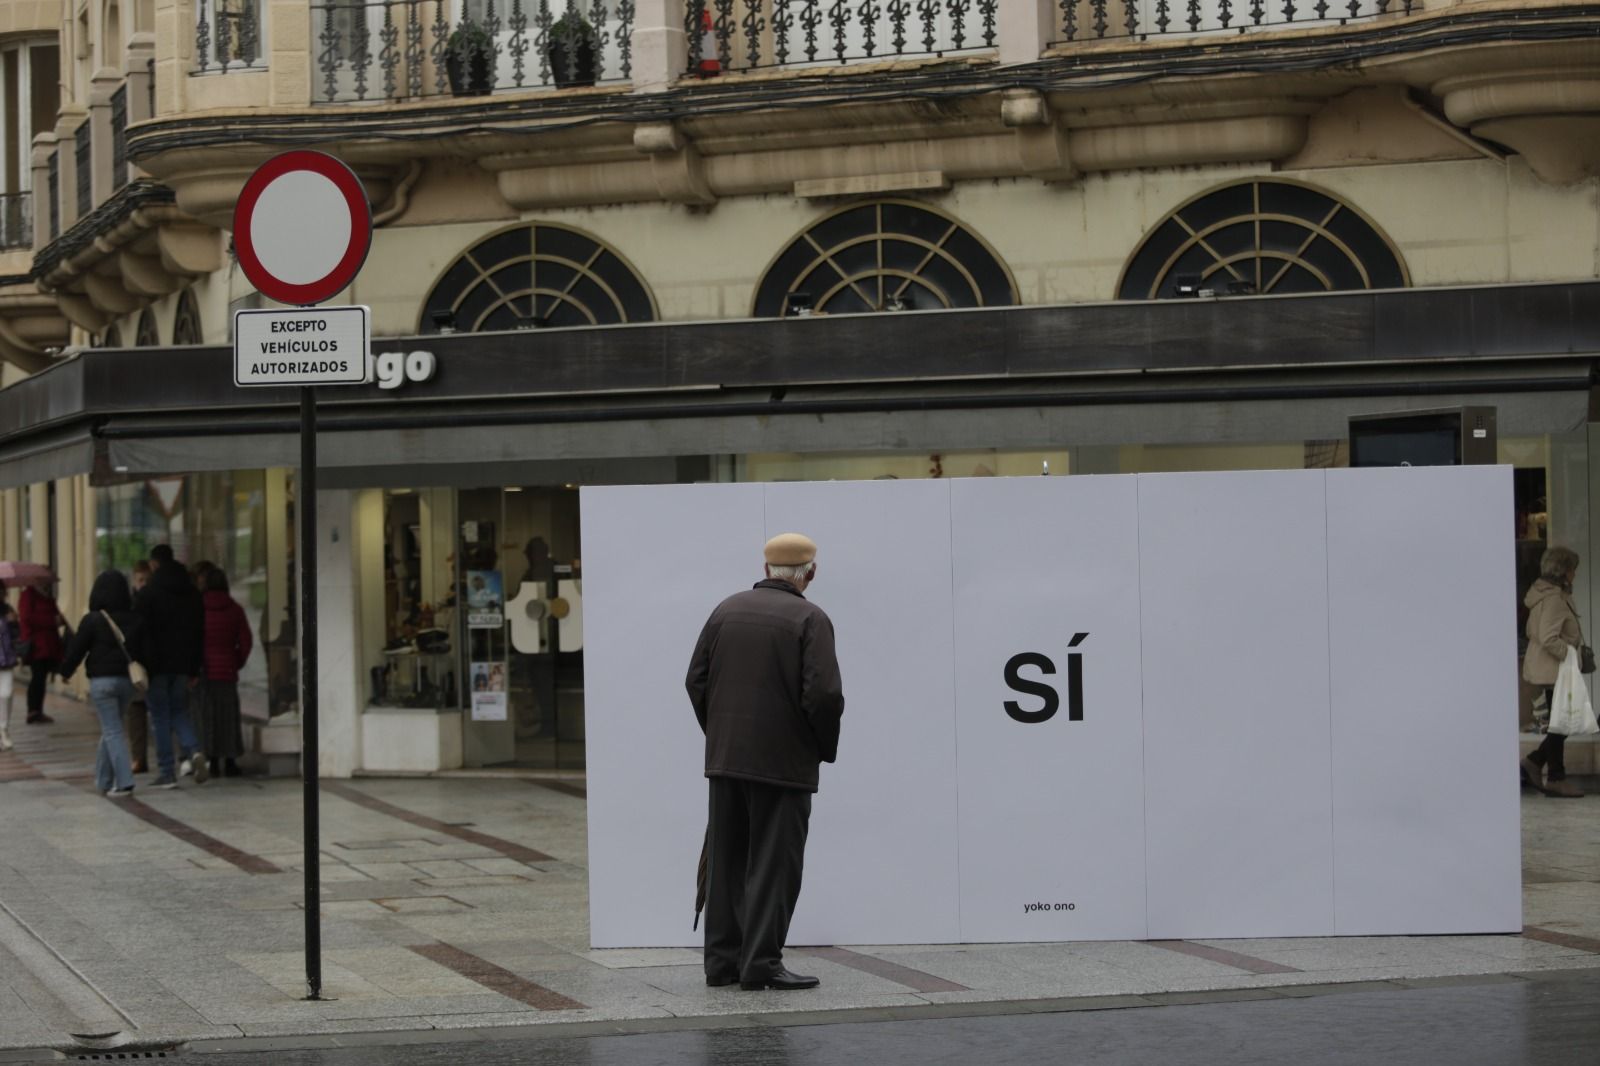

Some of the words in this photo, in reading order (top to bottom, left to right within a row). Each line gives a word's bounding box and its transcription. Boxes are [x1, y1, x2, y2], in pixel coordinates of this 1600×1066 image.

[271, 319, 327, 333] EXCEPTO
[261, 339, 338, 354] VEHÍCULOS
[251, 360, 348, 375] AUTORIZADOS
[1024, 901, 1051, 914] yoko
[1054, 902, 1076, 911] ono
